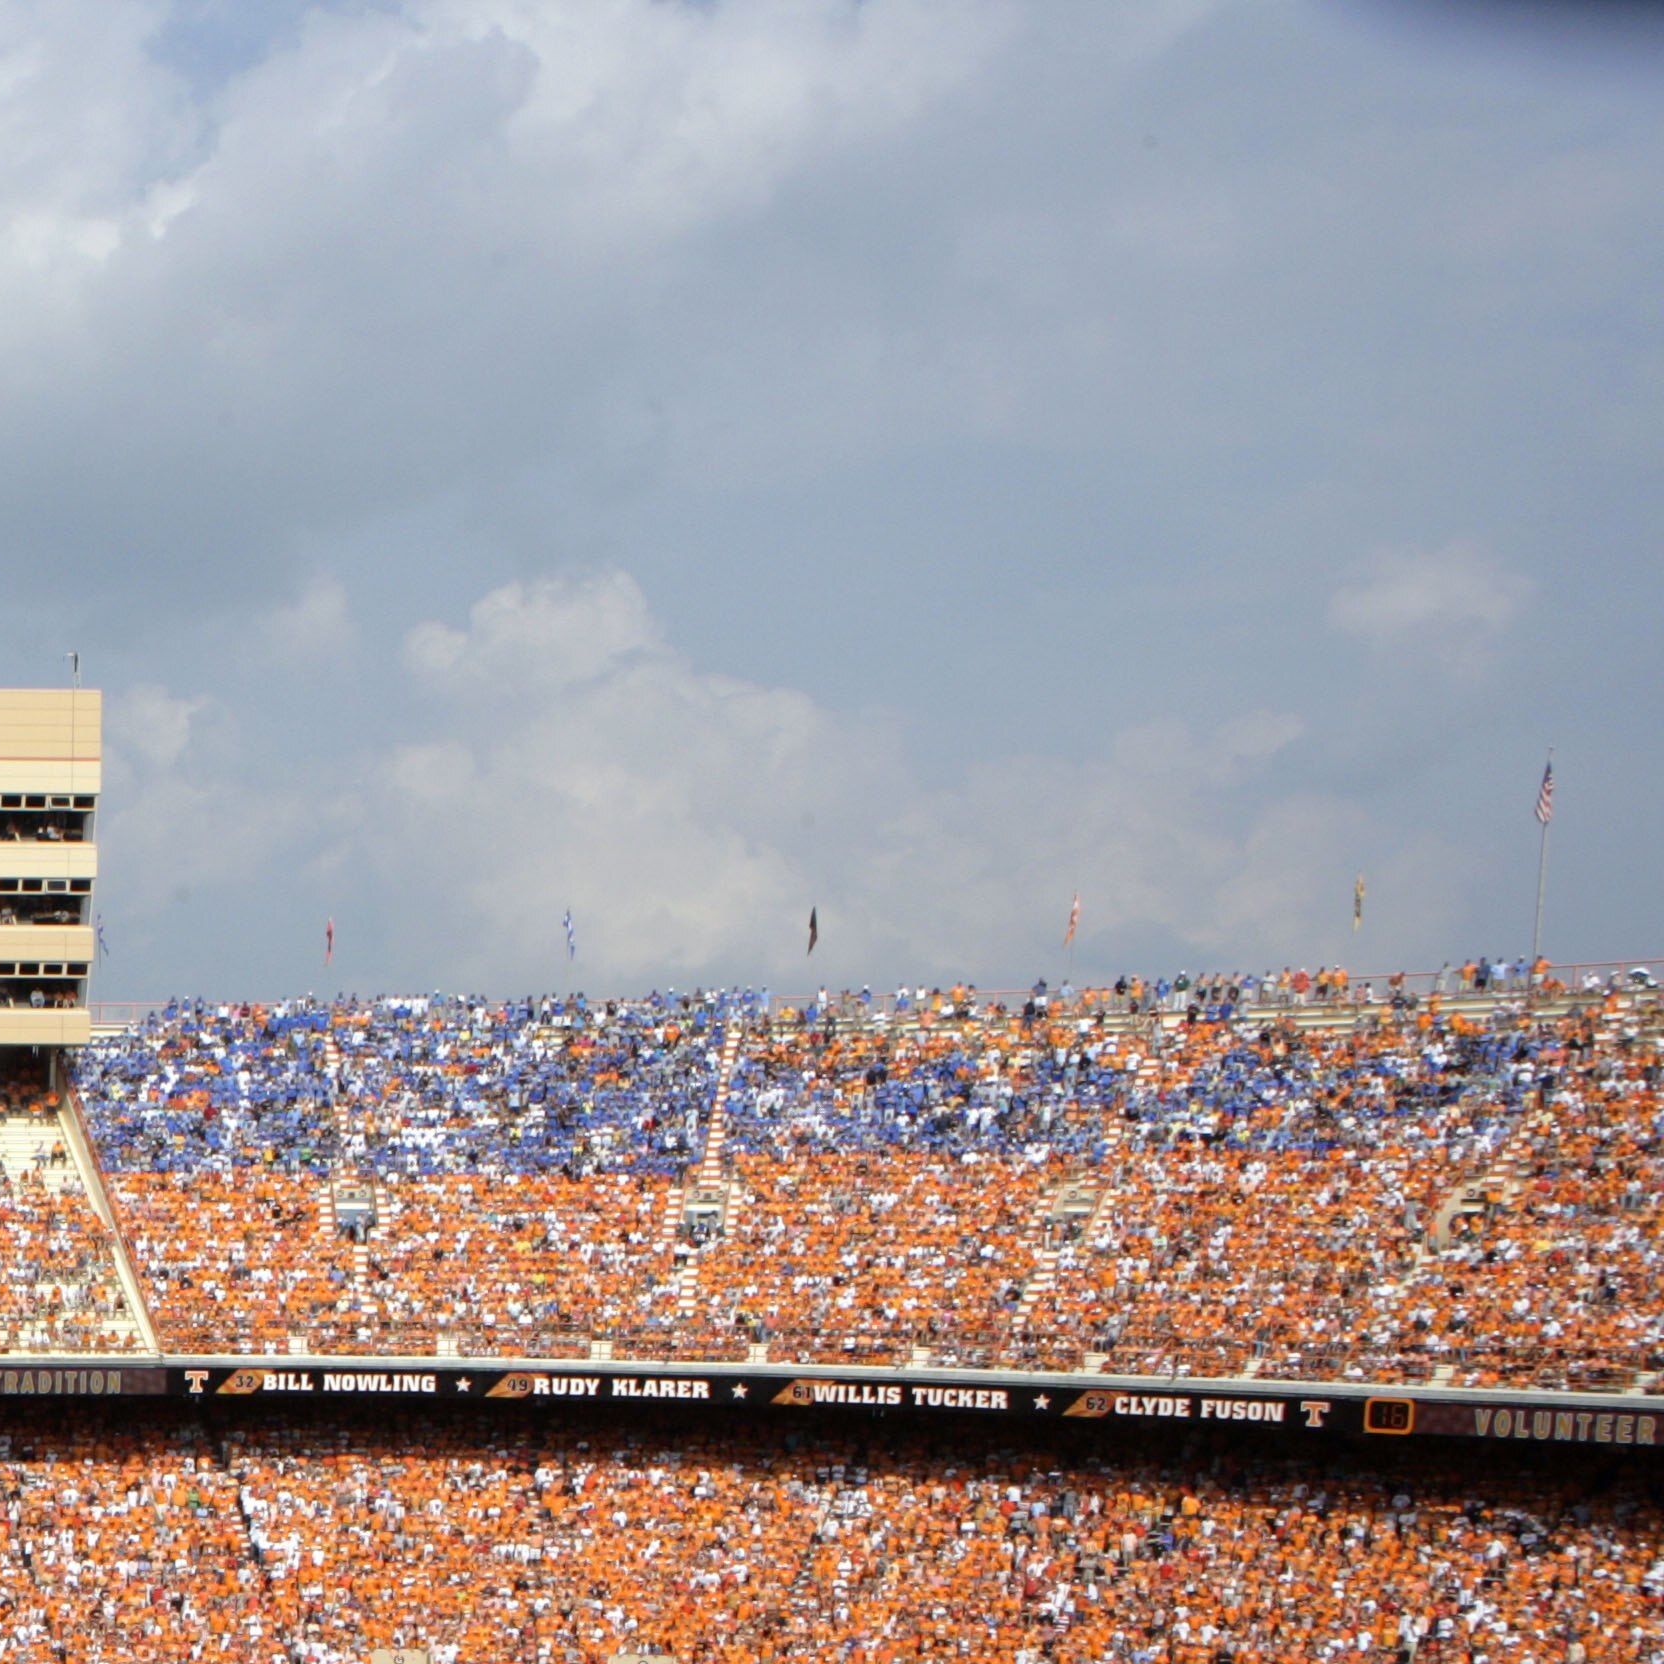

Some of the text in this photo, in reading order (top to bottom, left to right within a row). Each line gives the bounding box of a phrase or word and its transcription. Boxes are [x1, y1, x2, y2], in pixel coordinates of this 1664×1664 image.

[184, 1370, 209, 1394] T
[235, 1373, 436, 1393] 32 BILL NOWLING
[507, 1377, 709, 1399] 49 RUDY KLARER
[792, 1384, 1009, 1409] 61 WILLIS TUCKER
[1085, 1396, 1285, 1422] 62 CLYDE FUSON
[1300, 1401, 1331, 1427] T
[1473, 1407, 1656, 1445] VOLUNTEER
